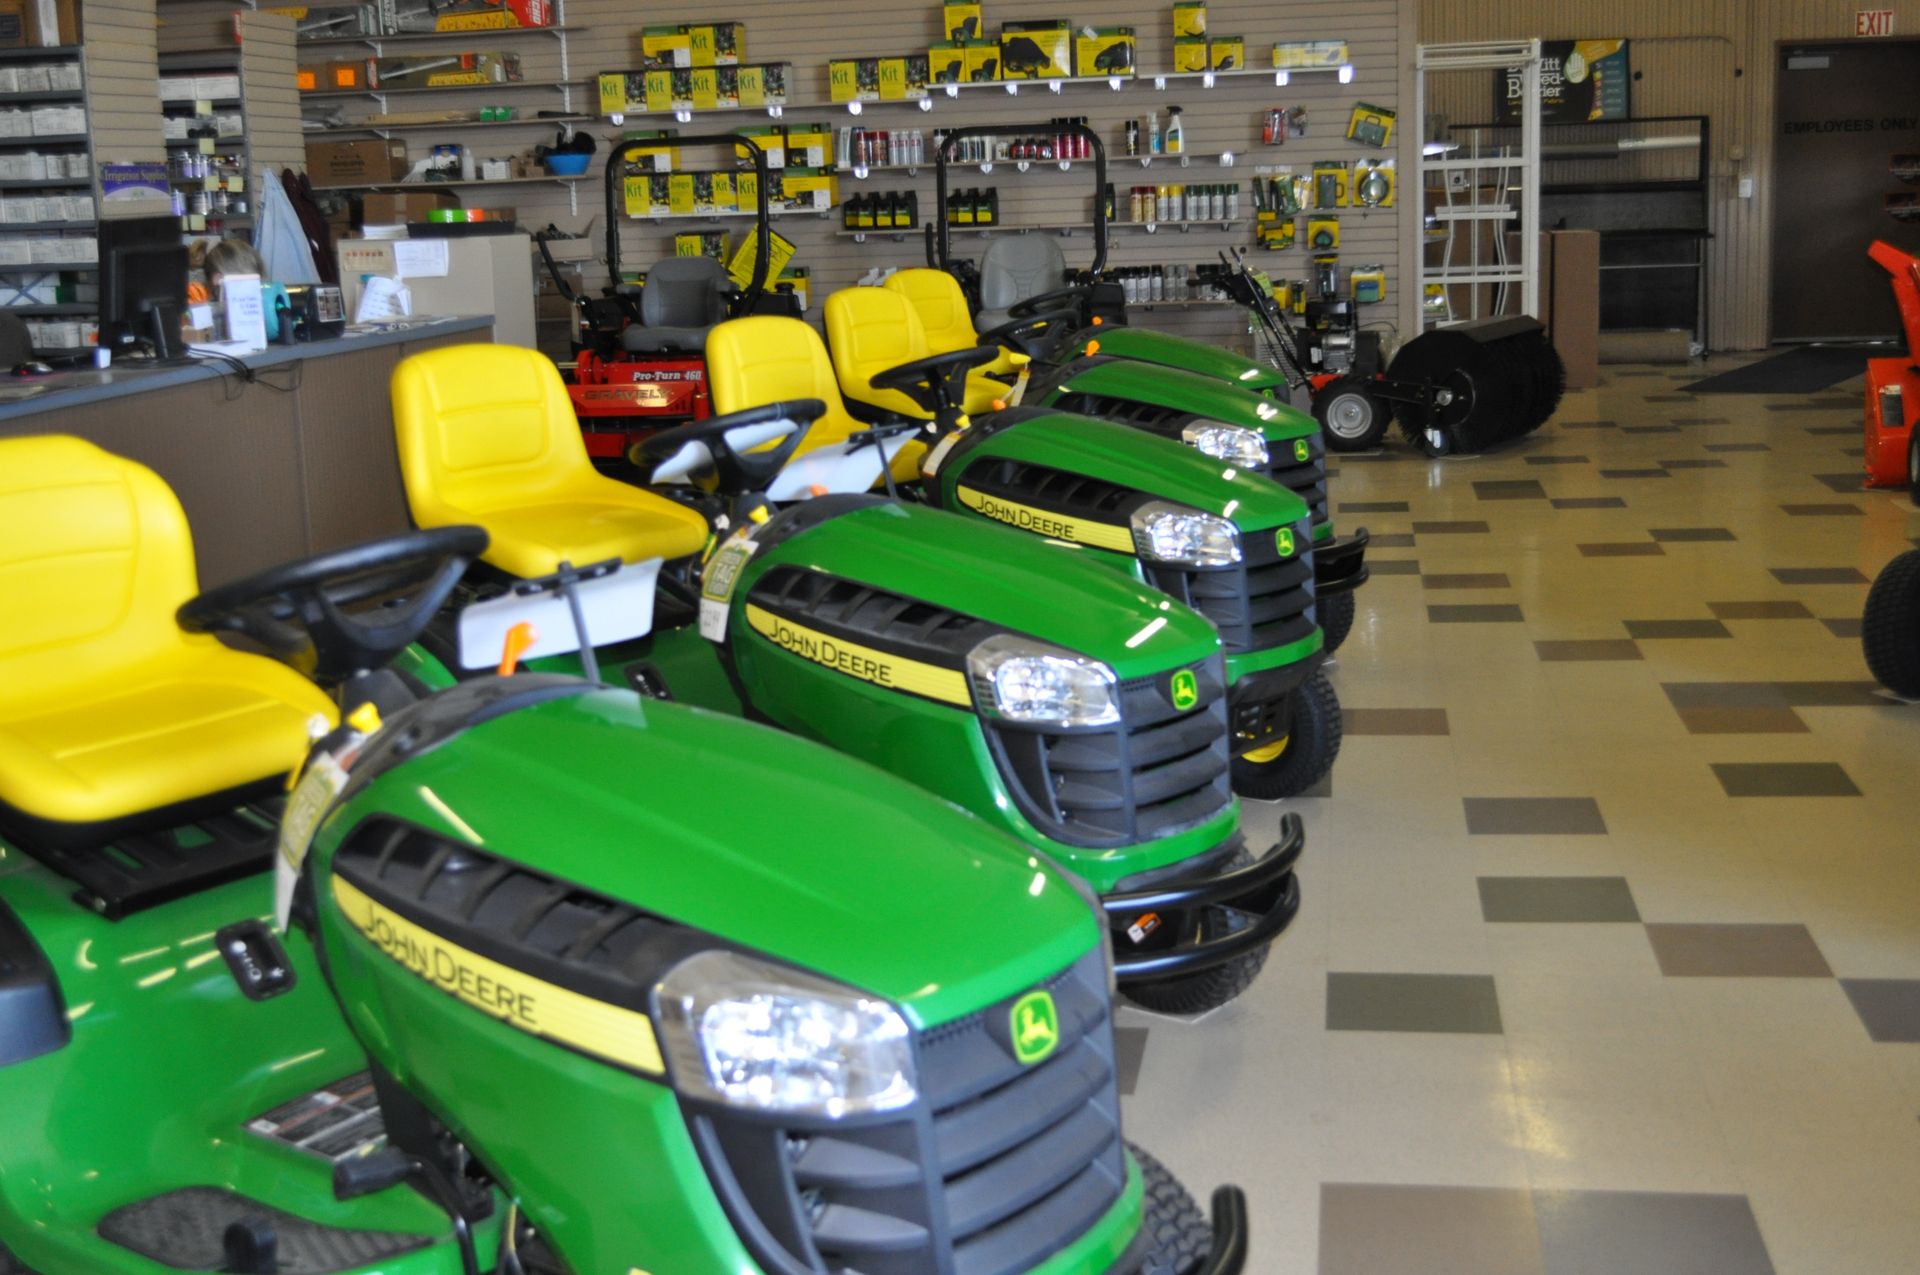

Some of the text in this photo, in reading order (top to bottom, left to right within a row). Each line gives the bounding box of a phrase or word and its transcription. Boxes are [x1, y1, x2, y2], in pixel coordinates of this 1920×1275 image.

[1856, 11, 1893, 36] EXIT
[691, 34, 708, 49] Kit
[832, 70, 849, 85] Kit
[881, 66, 898, 81] Kit
[602, 81, 618, 97] Kit
[648, 77, 665, 93] Kit
[693, 76, 710, 91] Kit
[739, 75, 756, 90] Kit
[1783, 117, 1918, 135] EMPLOYEES ONLY
[626, 183, 642, 198] Kit
[715, 179, 728, 192] Kit
[739, 180, 755, 195] Kit
[678, 242, 695, 256] Kit
[632, 370, 681, 381] Pro-Turn
[585, 388, 671, 401] GRAVELY
[976, 496, 1074, 539] JOHN DEERE
[769, 618, 892, 683] JOHN DEERE
[363, 903, 538, 1025] JOHN DEERE
